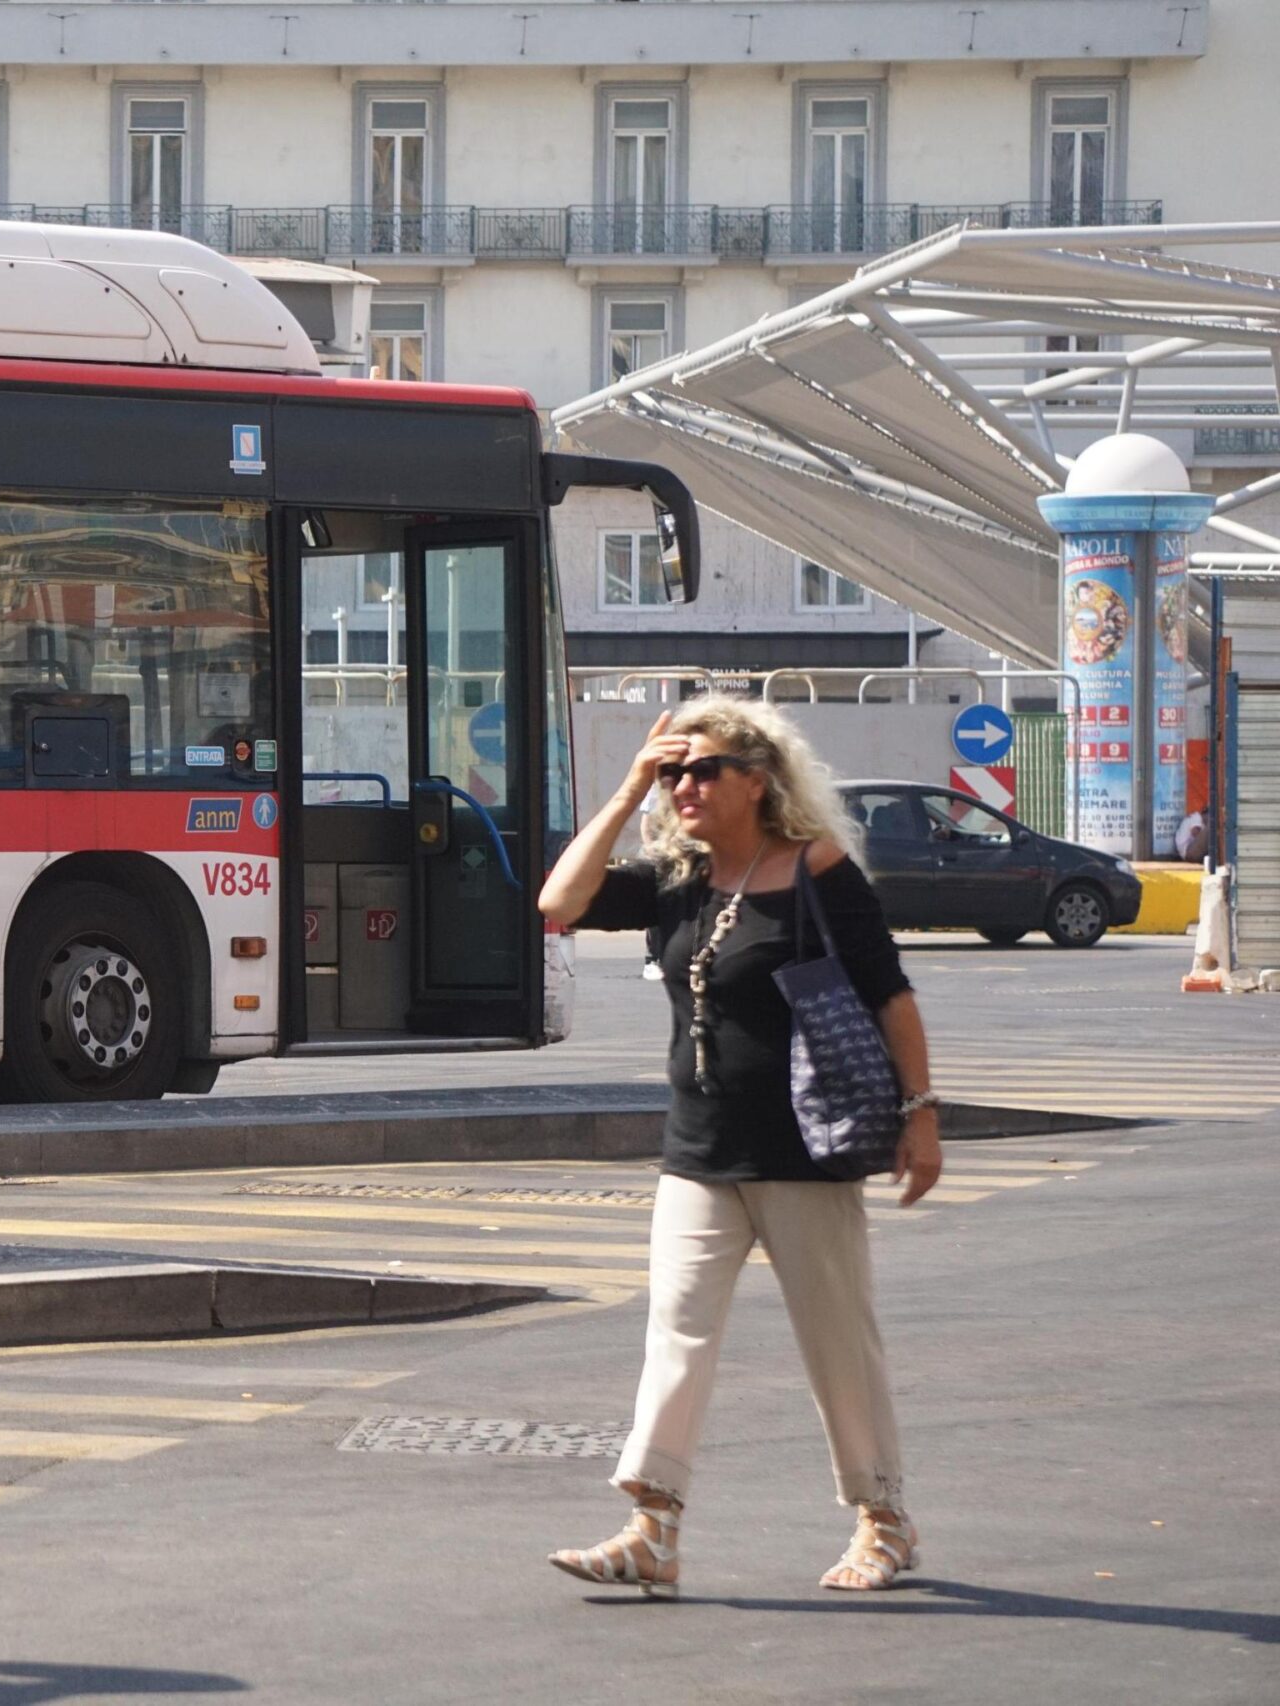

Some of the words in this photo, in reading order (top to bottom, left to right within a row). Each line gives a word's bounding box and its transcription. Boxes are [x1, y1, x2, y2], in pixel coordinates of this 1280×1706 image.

[1093, 555, 1129, 567] MONDO
[1108, 707, 1121, 720] 2
[1108, 744, 1121, 756] 9
[187, 751, 223, 762] ENTRATA
[195, 811, 236, 829] anm
[202, 862, 271, 896] V834
